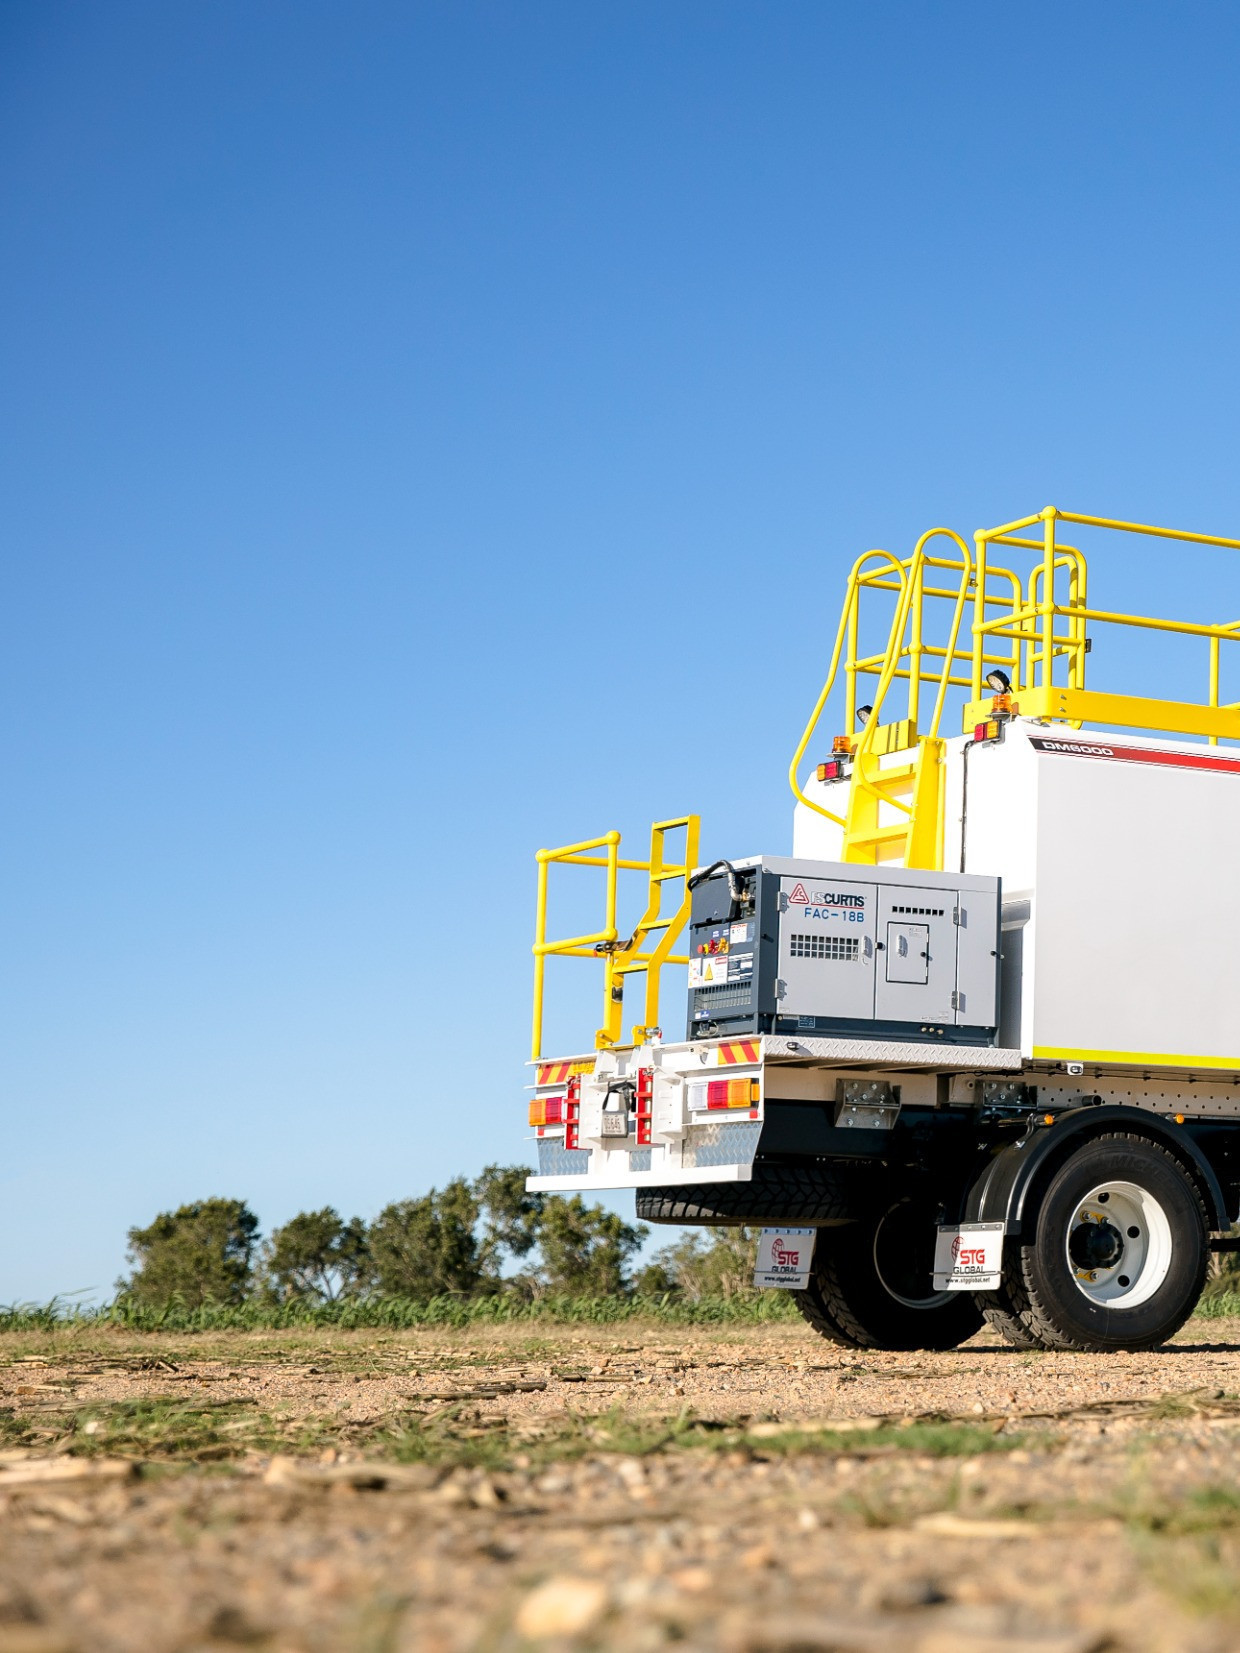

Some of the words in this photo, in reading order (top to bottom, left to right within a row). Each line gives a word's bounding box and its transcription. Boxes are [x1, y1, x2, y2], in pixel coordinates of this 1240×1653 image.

[1042, 741, 1114, 756] DM6000
[804, 907, 865, 922] FAC-18B
[778, 1251, 799, 1265] STG
[960, 1249, 985, 1265] STG
[772, 1265, 797, 1274] GLOBAL
[953, 1265, 985, 1274] GLOBAL
